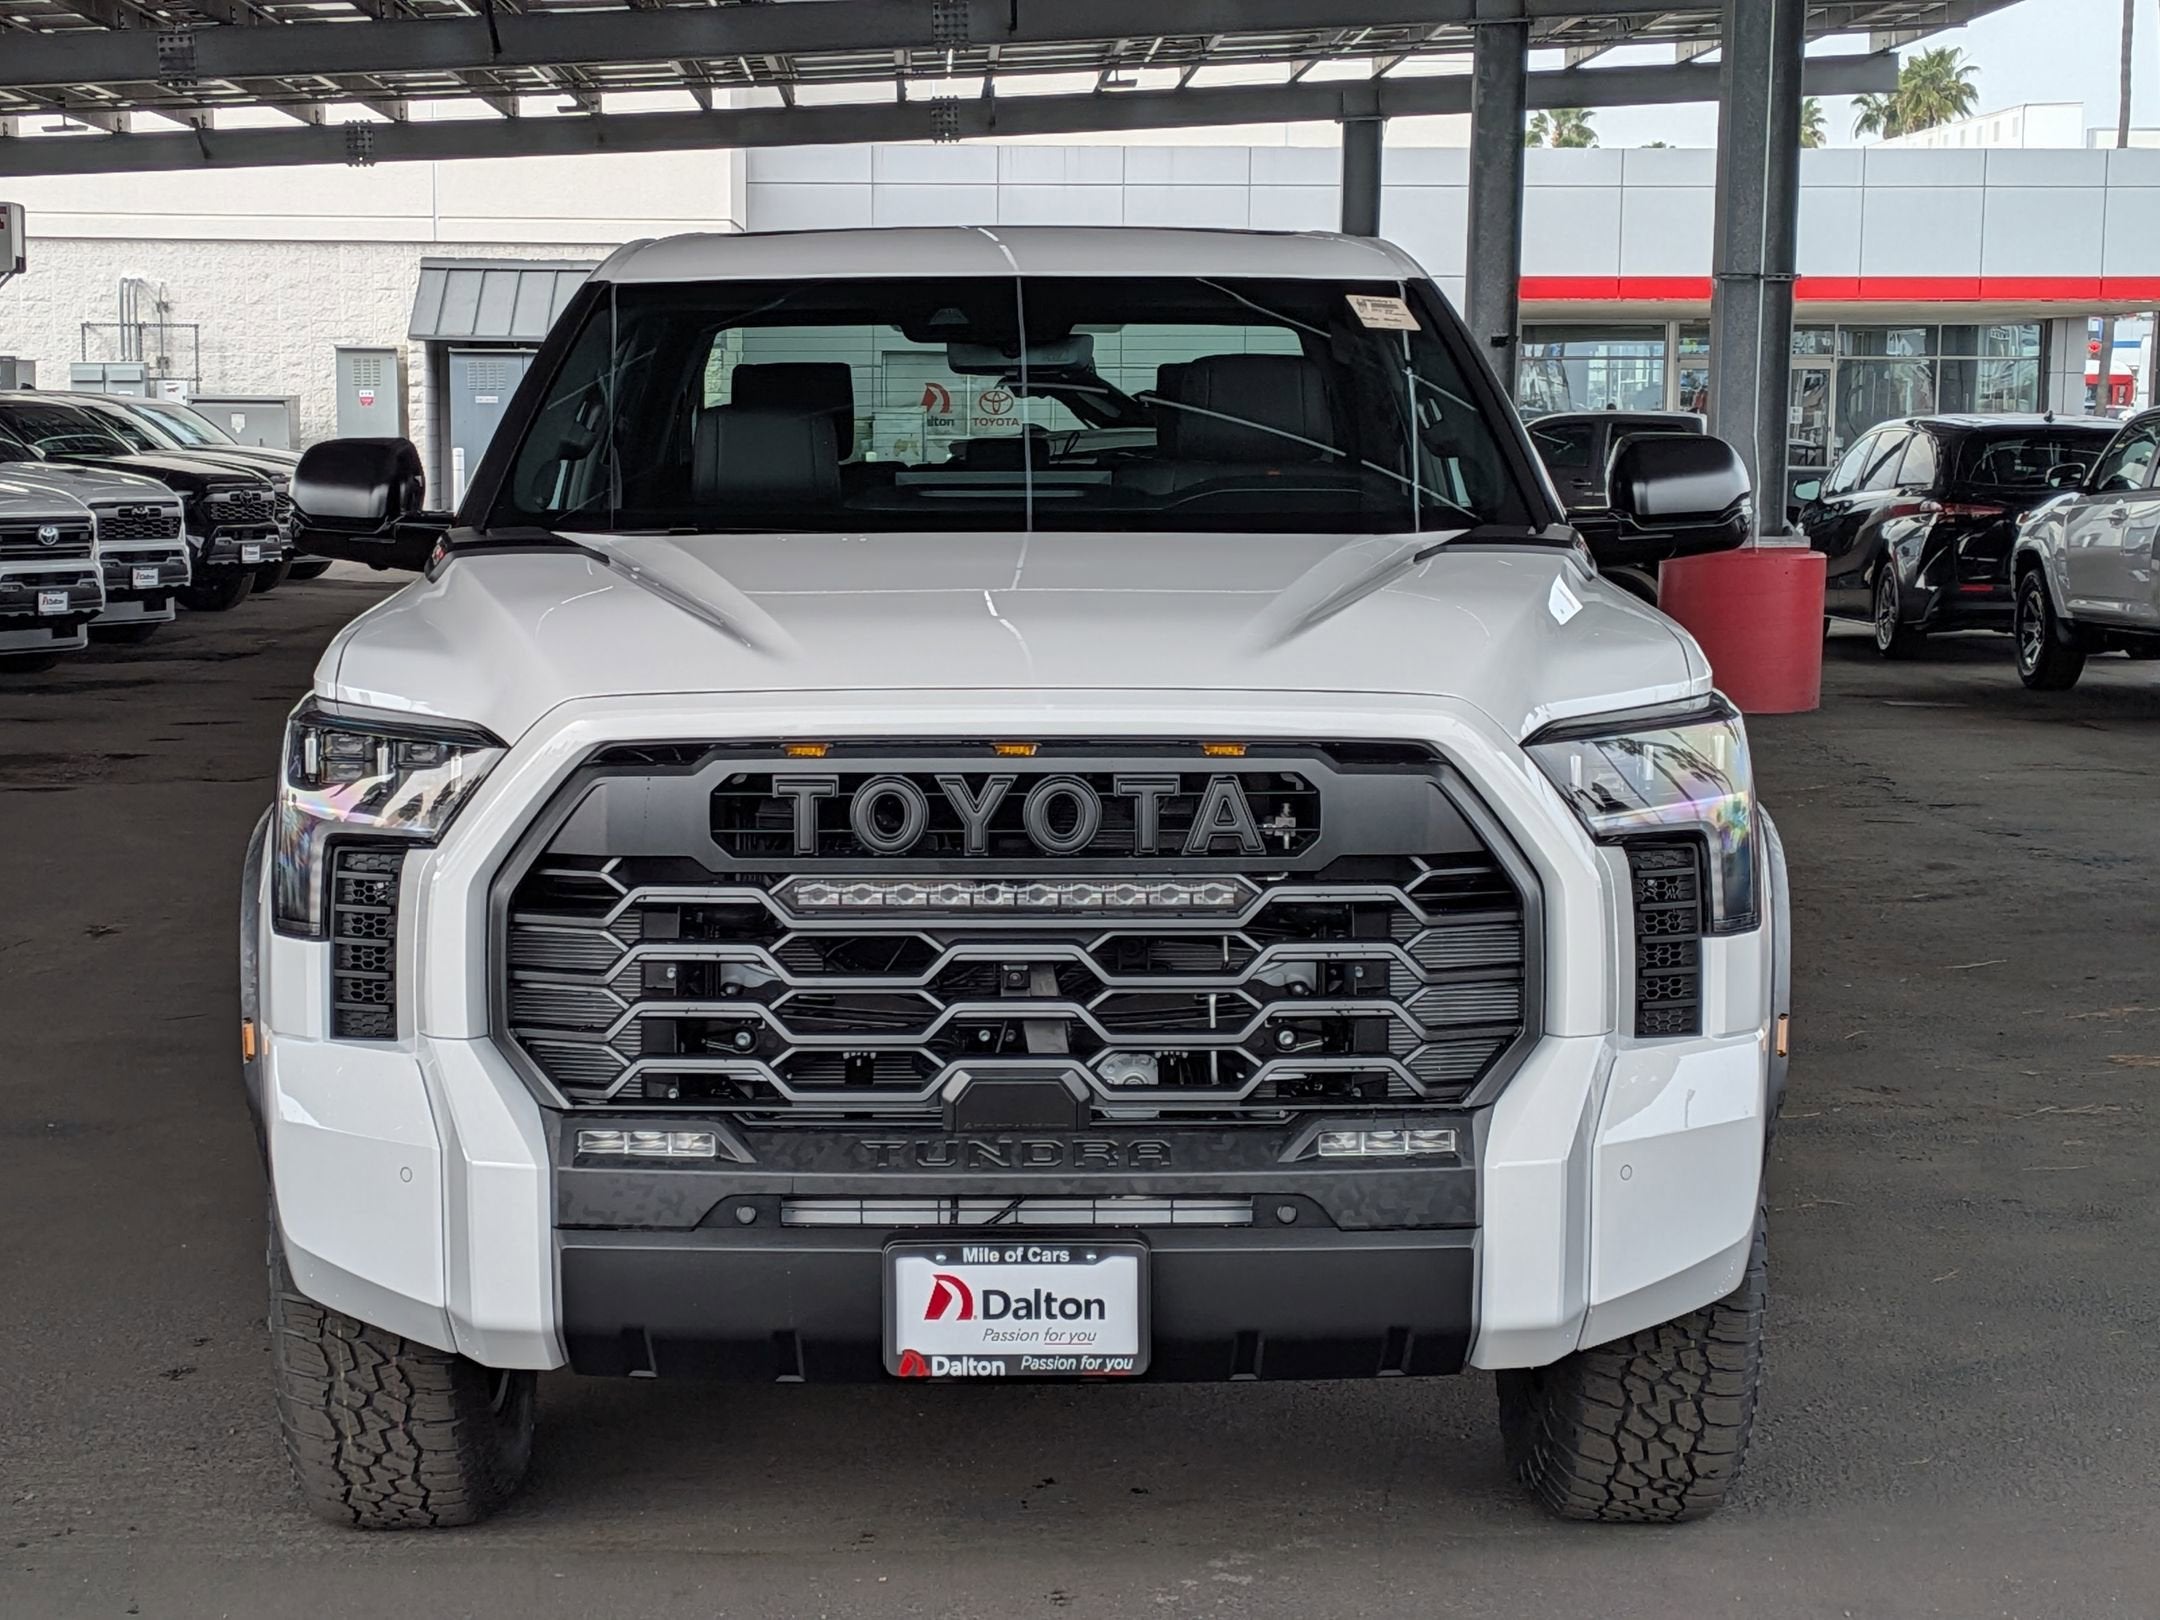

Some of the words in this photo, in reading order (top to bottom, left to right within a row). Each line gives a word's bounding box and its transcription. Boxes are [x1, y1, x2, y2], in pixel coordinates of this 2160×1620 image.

[972, 417, 1020, 427] TOYOTA
[772, 773, 1267, 857] TOYOTA
[860, 1139, 1172, 1167] TUNDRA
[963, 1247, 1000, 1263] Mile
[1004, 1247, 1024, 1263] of
[1027, 1247, 1070, 1263] Cars
[982, 1288, 1106, 1321] Dalton
[982, 1327, 1040, 1343] Passion
[1043, 1327, 1064, 1343] for
[1068, 1332, 1097, 1346] you
[931, 1356, 1006, 1376] Dalton
[1020, 1355, 1077, 1371] Passion
[1080, 1355, 1101, 1371] for
[1103, 1358, 1133, 1373] you
